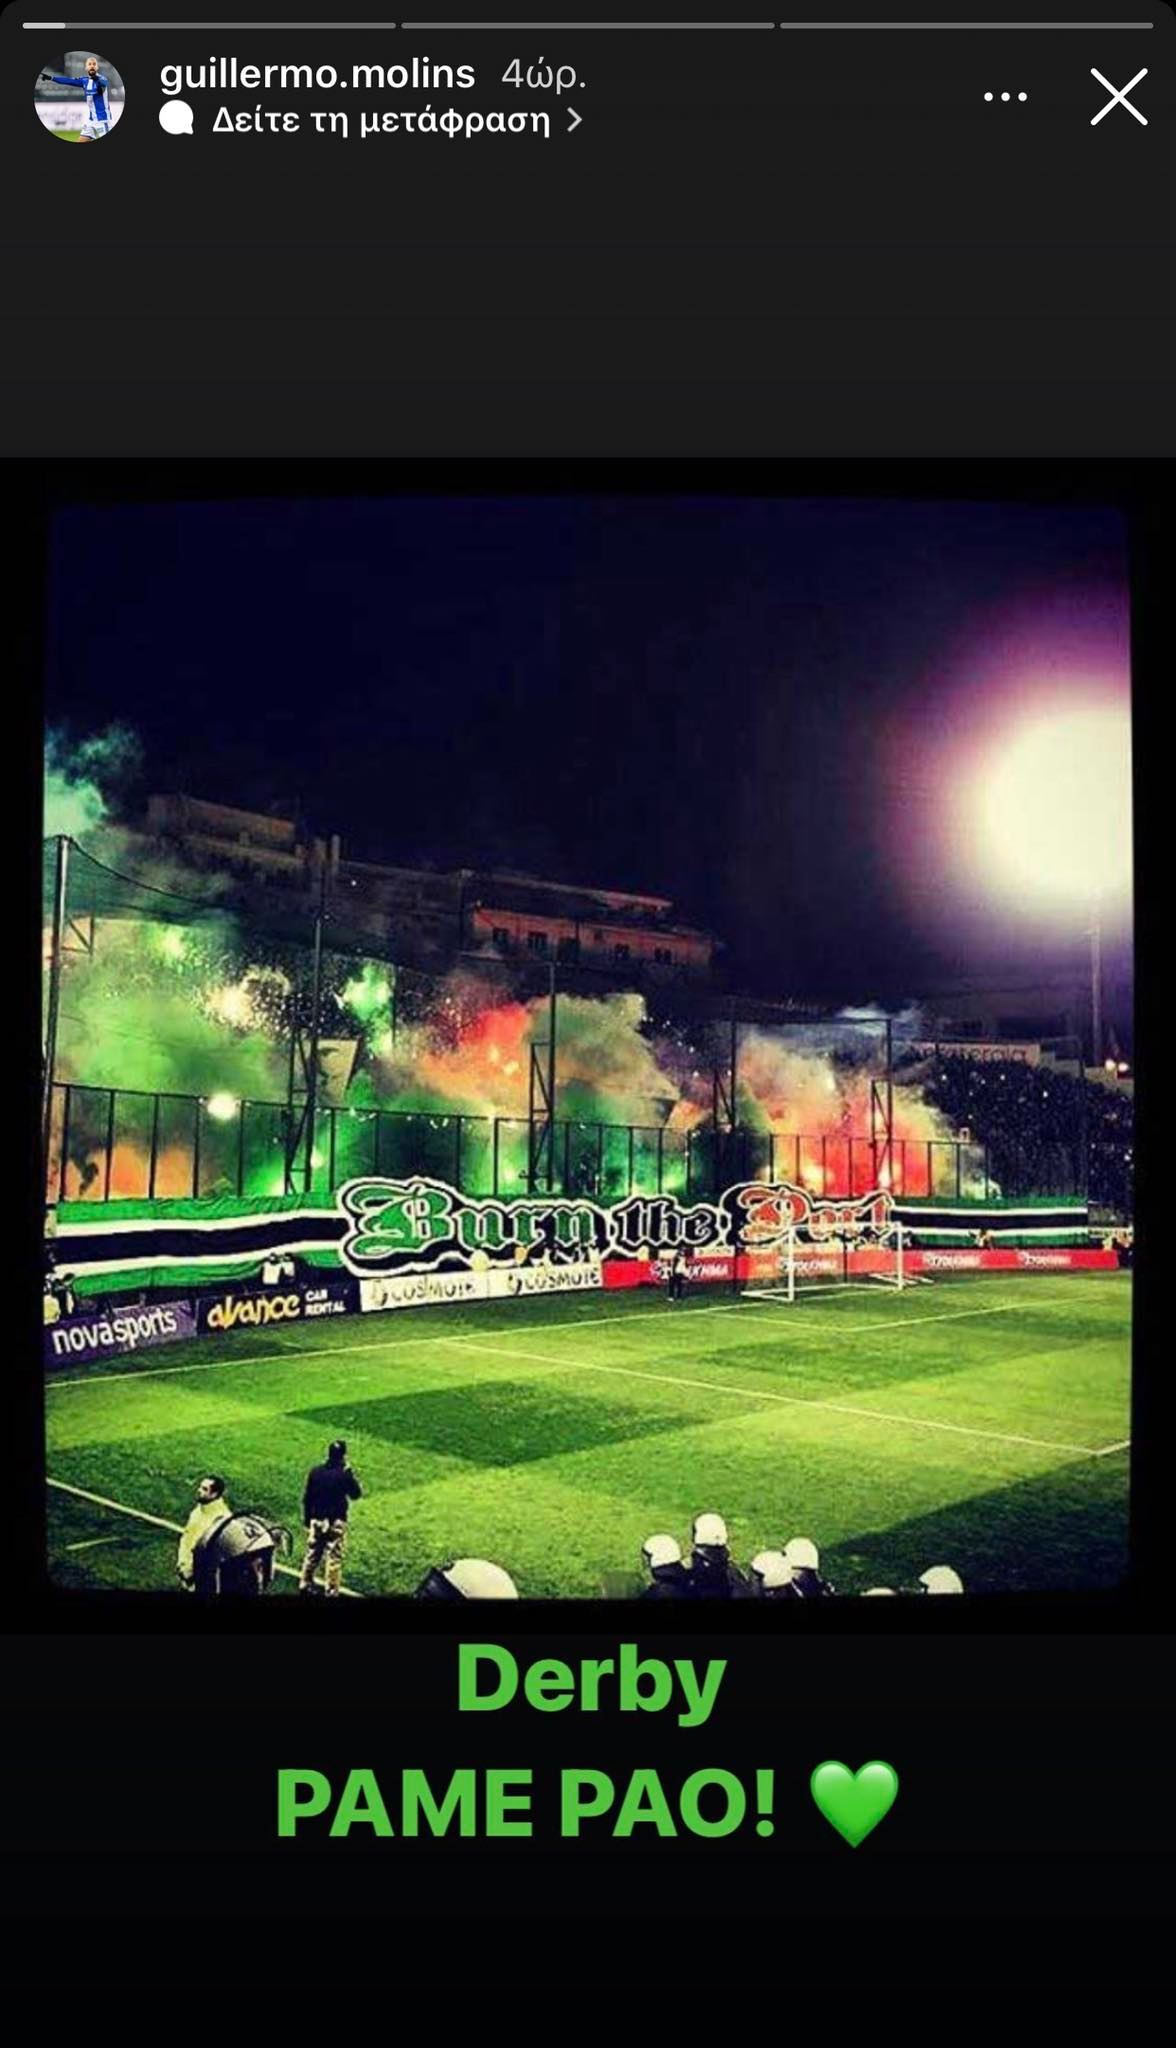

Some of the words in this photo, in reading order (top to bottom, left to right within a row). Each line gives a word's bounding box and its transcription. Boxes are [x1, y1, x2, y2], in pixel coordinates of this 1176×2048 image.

[343, 1181, 604, 1261] Burn
[614, 1198, 716, 1248] the
[51, 1307, 178, 1355] novasports
[304, 1300, 346, 1316] RENTAL
